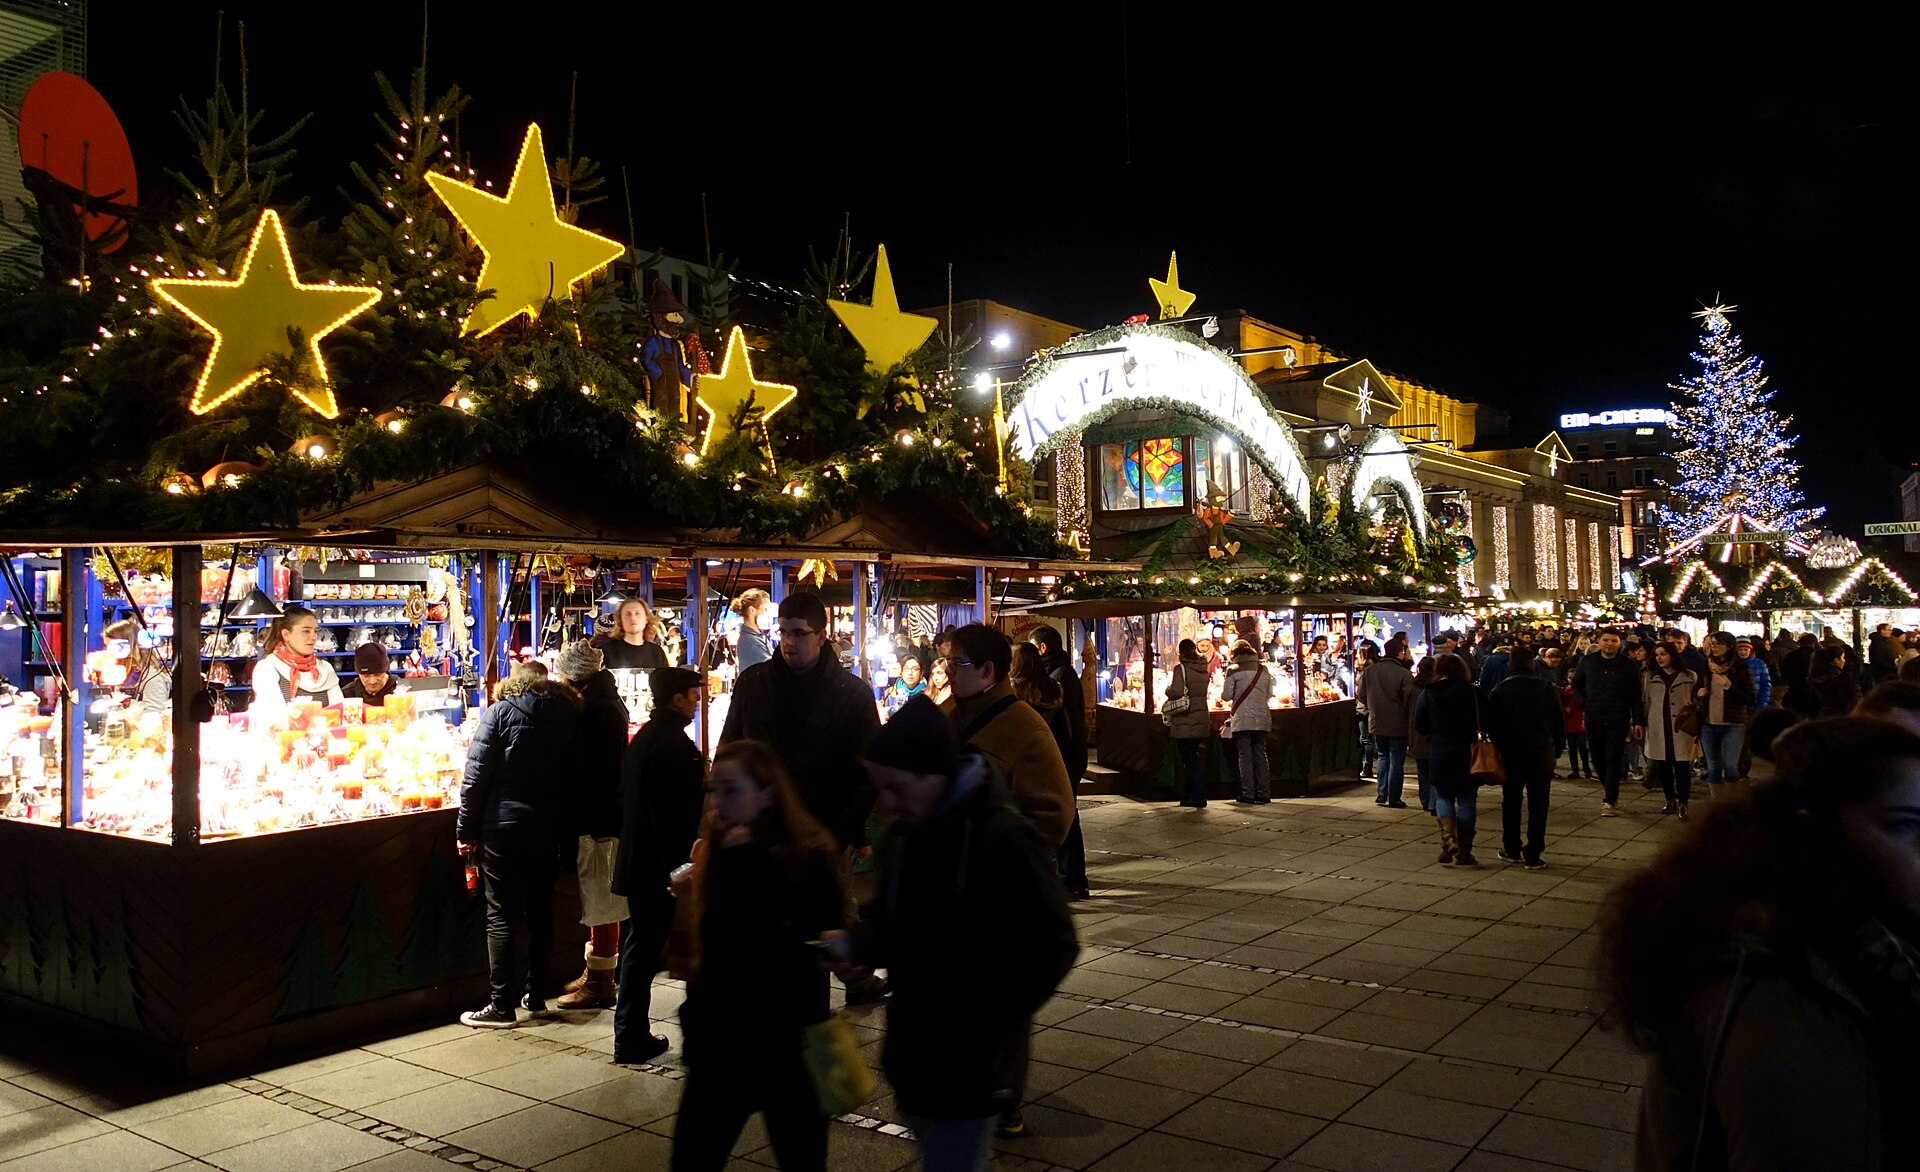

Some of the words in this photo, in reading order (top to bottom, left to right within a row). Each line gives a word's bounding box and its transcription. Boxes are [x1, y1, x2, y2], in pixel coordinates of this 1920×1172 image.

[1868, 523, 1920, 535] ORIGINAL
[1703, 534, 1735, 544] ORIGINAL
[1737, 532, 1786, 542] ERZGEBIRGE
